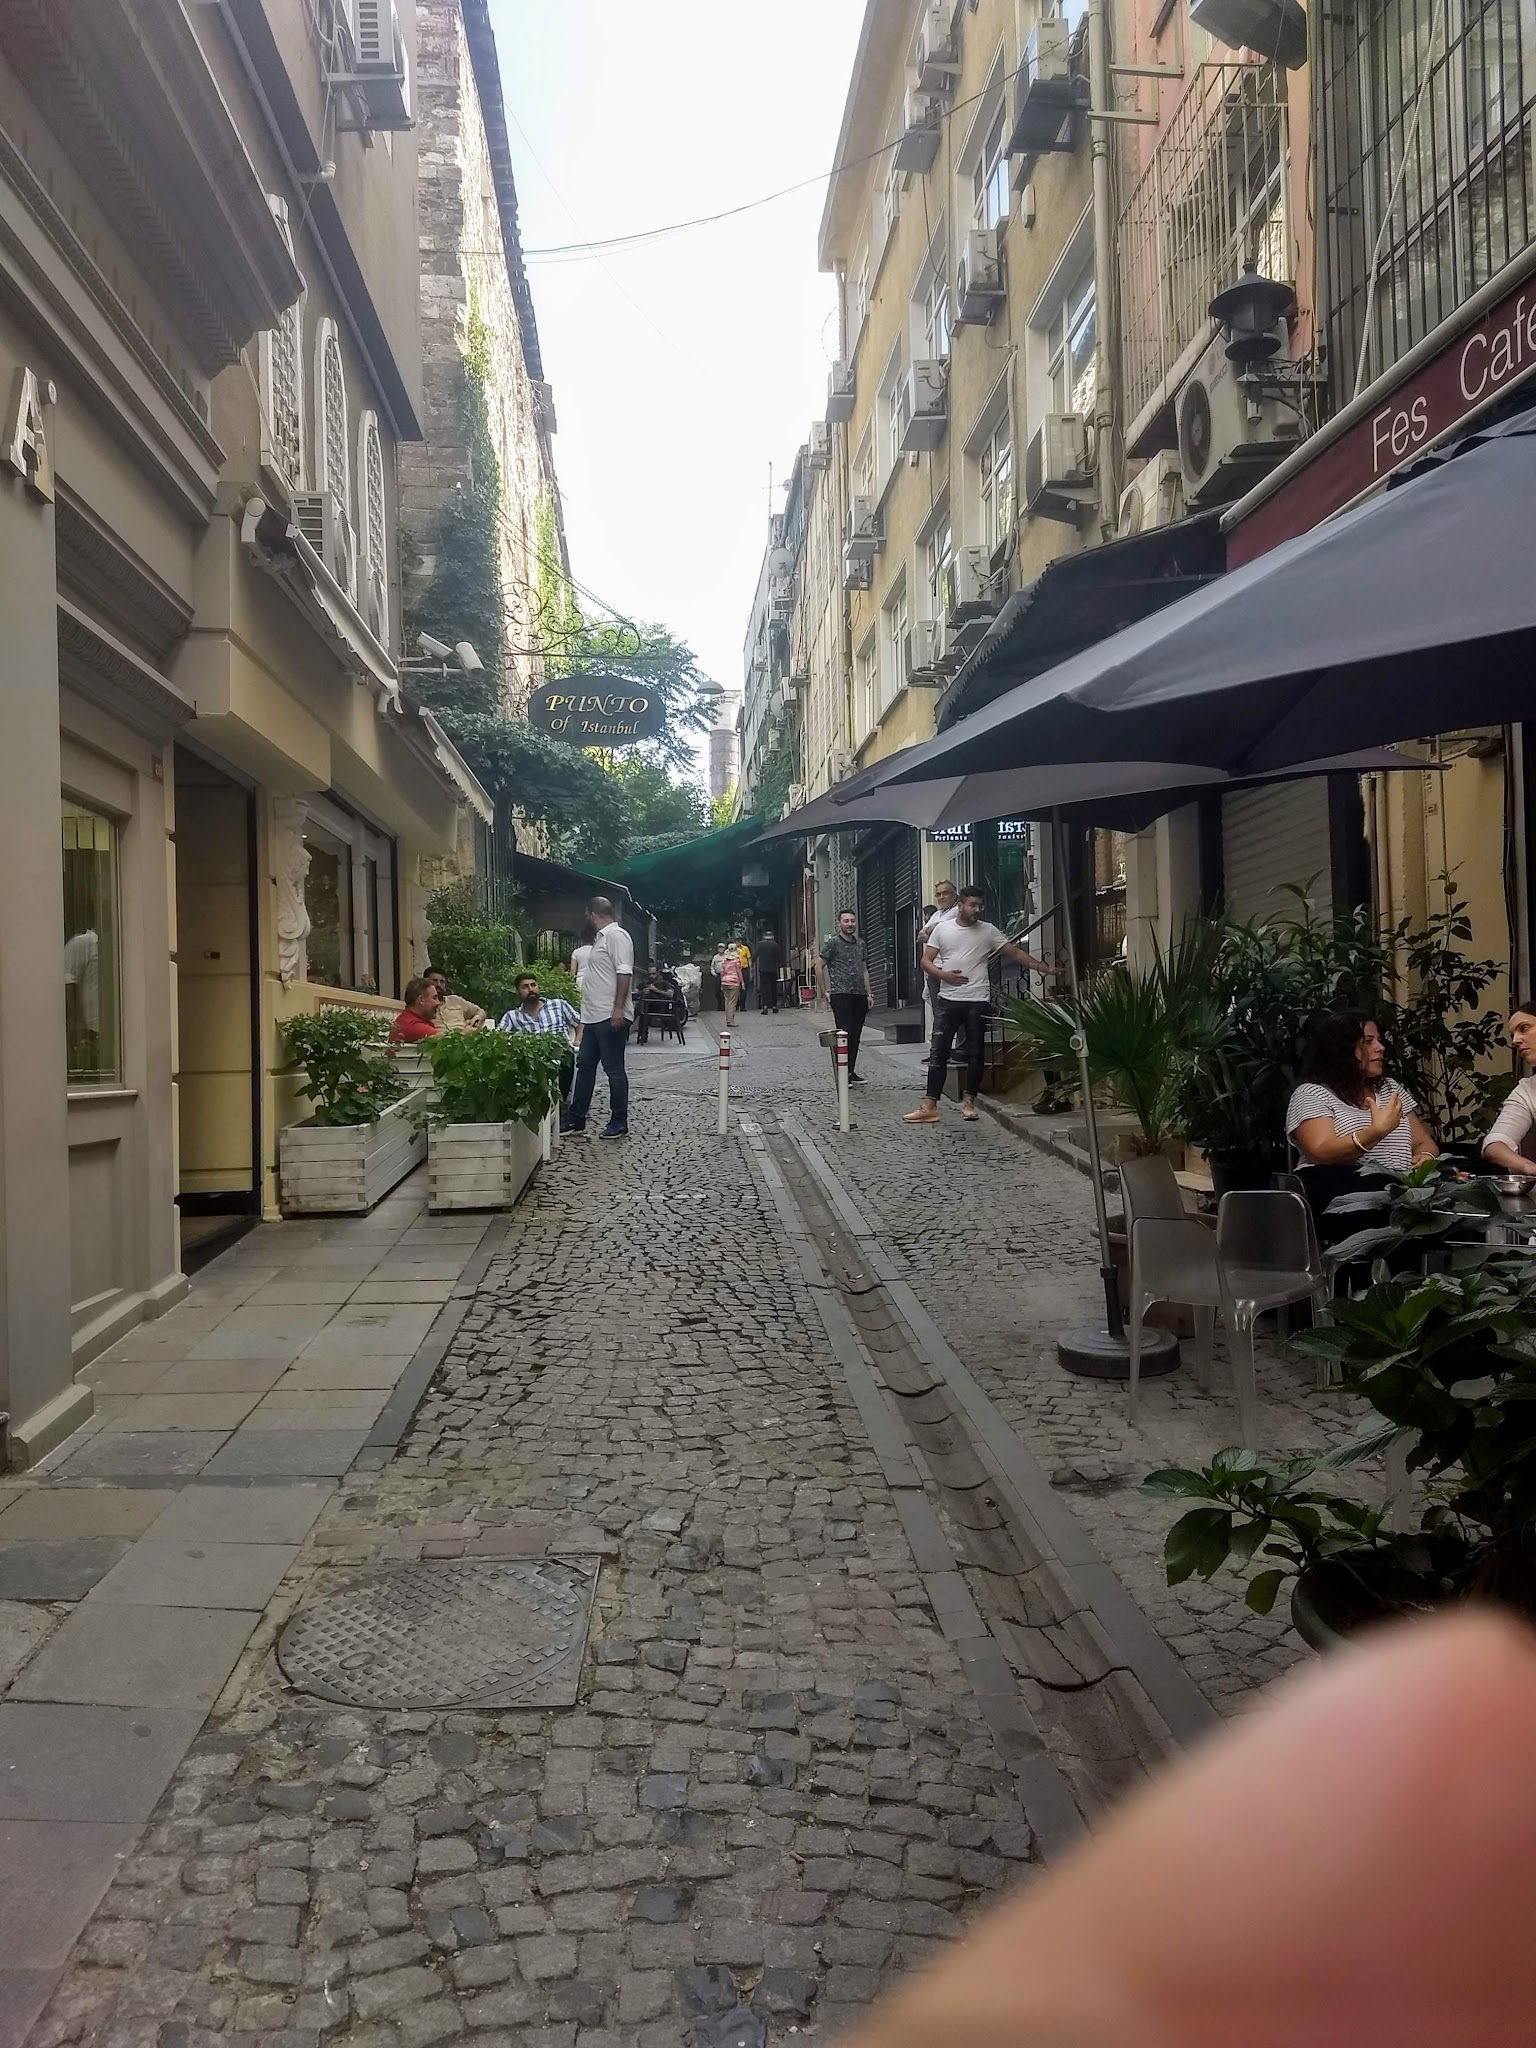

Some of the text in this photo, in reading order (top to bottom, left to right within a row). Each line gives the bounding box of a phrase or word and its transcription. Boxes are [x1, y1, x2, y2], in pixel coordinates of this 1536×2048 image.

[1372, 396, 1428, 472] Fes
[545, 694, 649, 717] PUNTO
[551, 715, 640, 735] Of Istanbul
